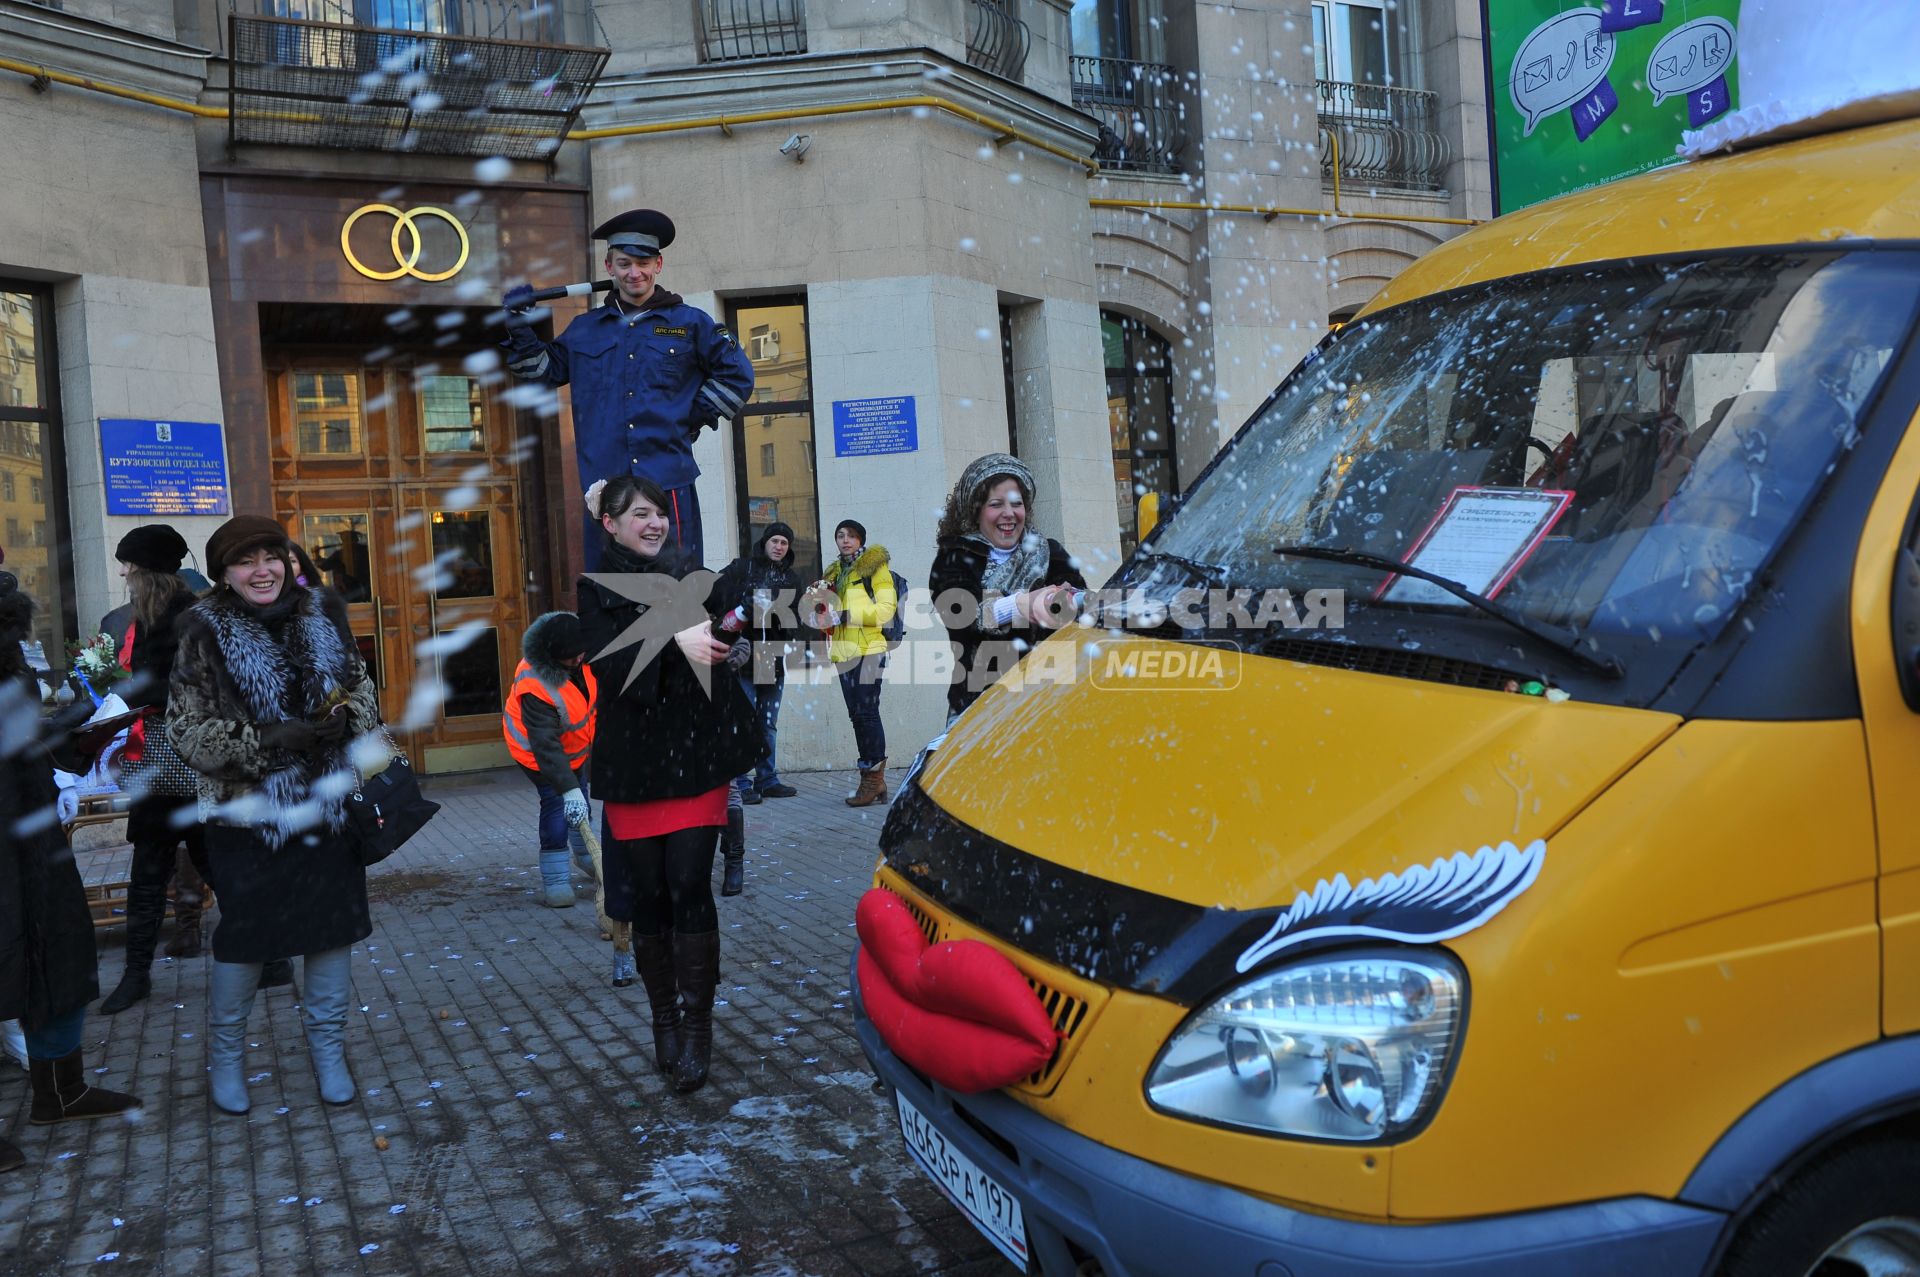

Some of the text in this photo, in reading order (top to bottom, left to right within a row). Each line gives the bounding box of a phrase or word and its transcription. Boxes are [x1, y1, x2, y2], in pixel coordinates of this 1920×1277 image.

[1586, 95, 1606, 122] M
[1700, 91, 1713, 115] S
[110, 457, 221, 469] КУТУЗОВСКИЙ ОТДЕЛ ЗАГС
[1460, 508, 1536, 518] СВИДЕТЕЛЬСТВО
[992, 1215, 1012, 1240] RUS
